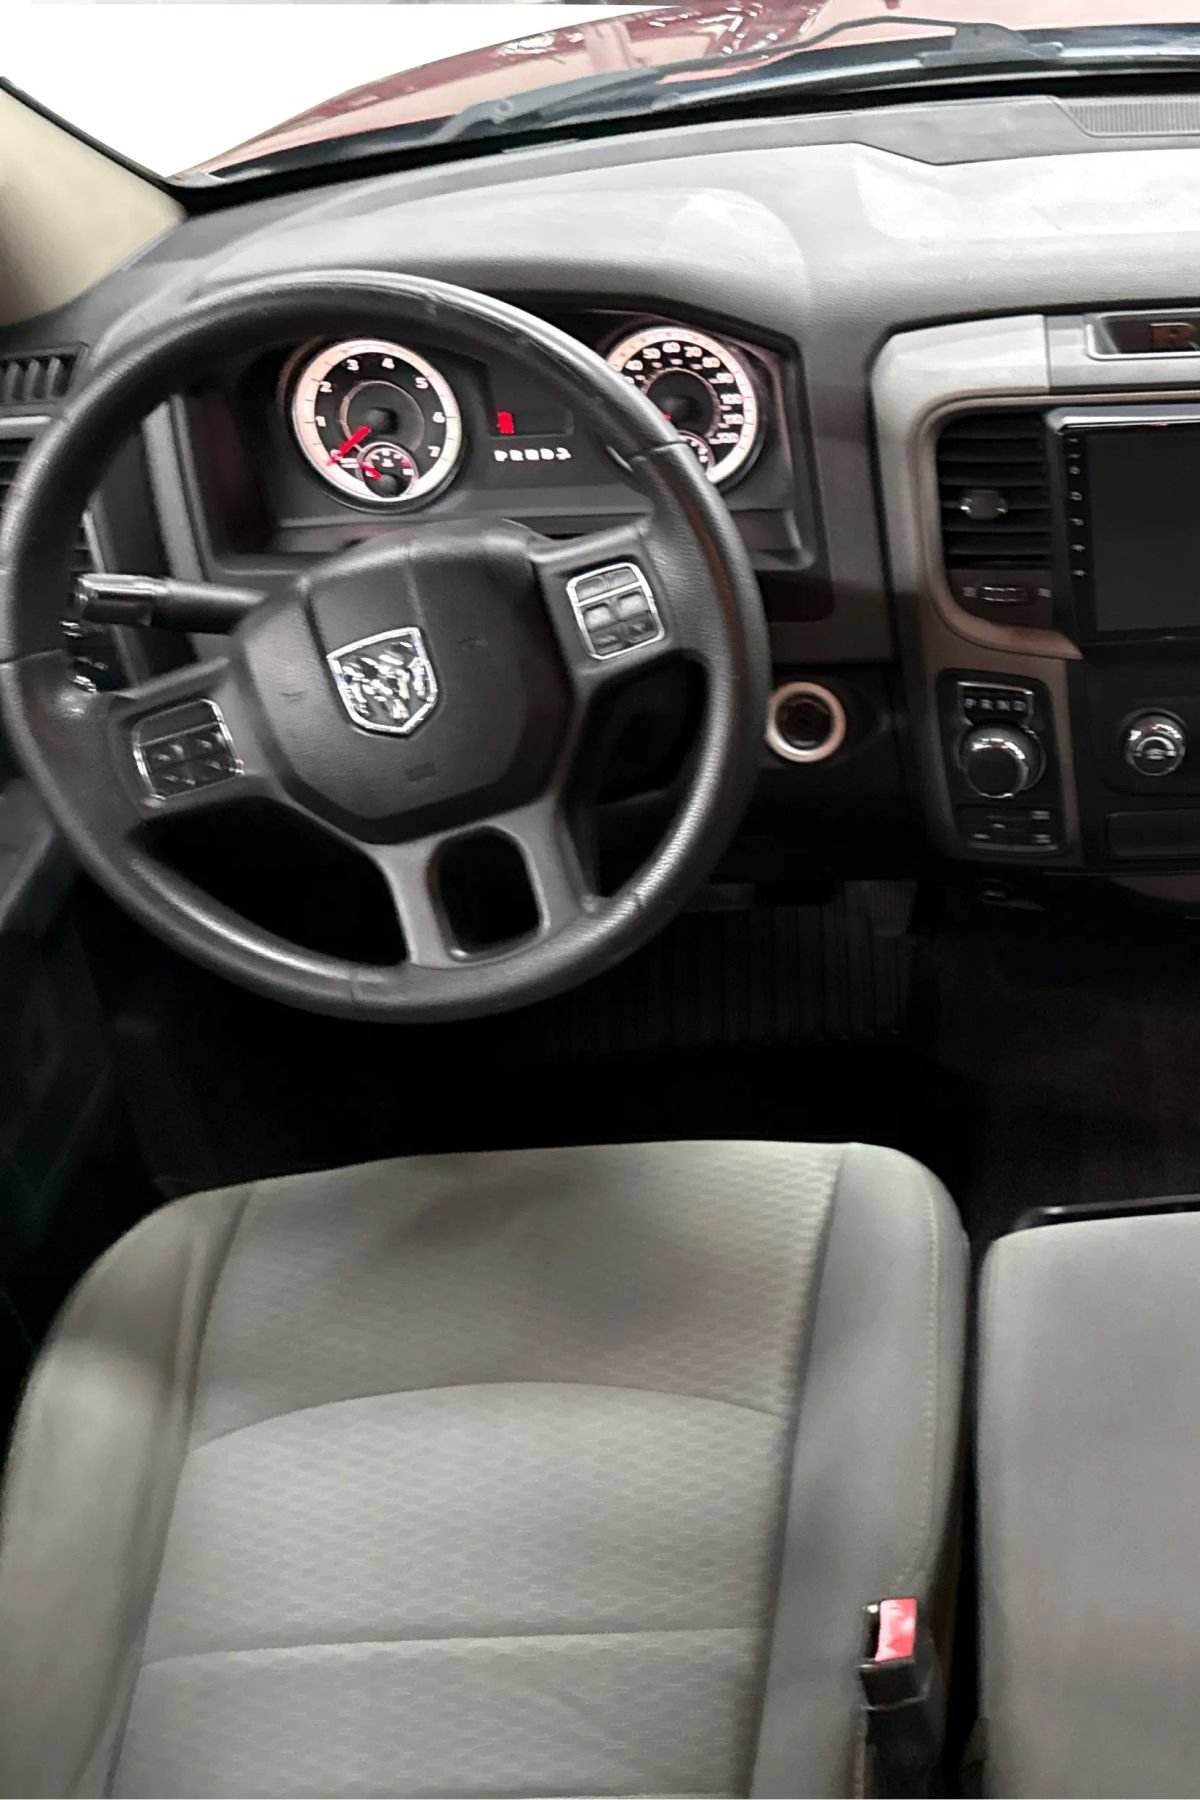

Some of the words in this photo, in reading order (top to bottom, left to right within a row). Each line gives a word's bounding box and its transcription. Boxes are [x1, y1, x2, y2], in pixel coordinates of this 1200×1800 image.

[346, 359, 359, 371] 3
[320, 381, 333, 392] 2
[415, 377, 429, 389] 5
